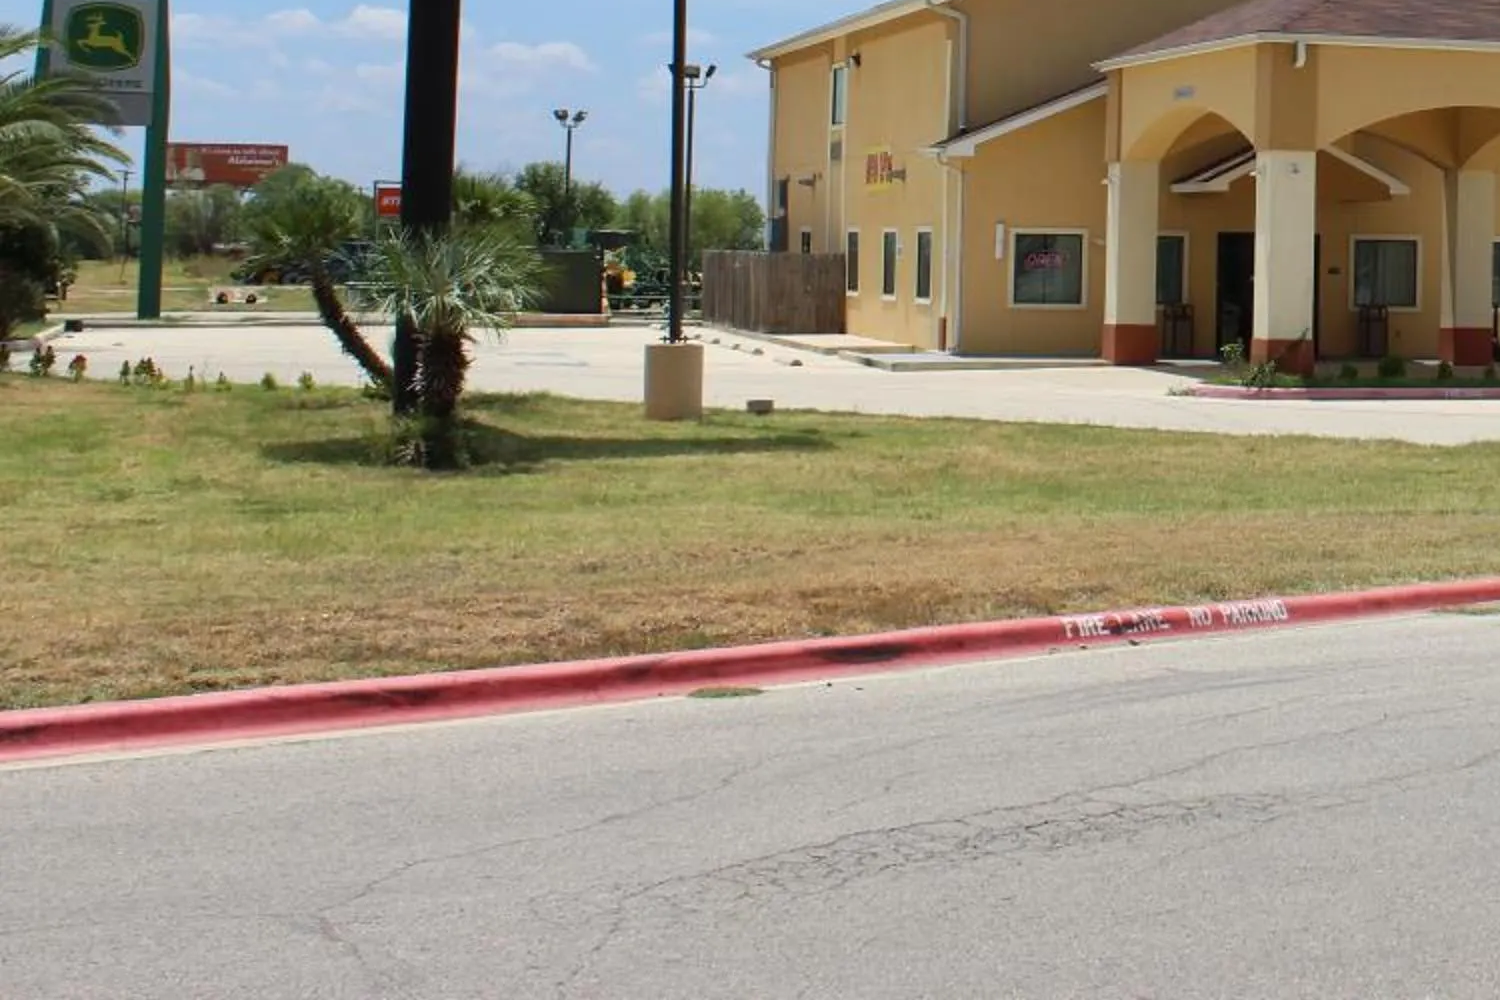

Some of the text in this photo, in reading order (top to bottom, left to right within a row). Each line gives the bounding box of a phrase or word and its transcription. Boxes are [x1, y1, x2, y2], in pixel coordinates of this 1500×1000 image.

[1060, 615, 1110, 639] FIRE
[1184, 606, 1212, 628] NO
[1218, 599, 1288, 626] PARKING
